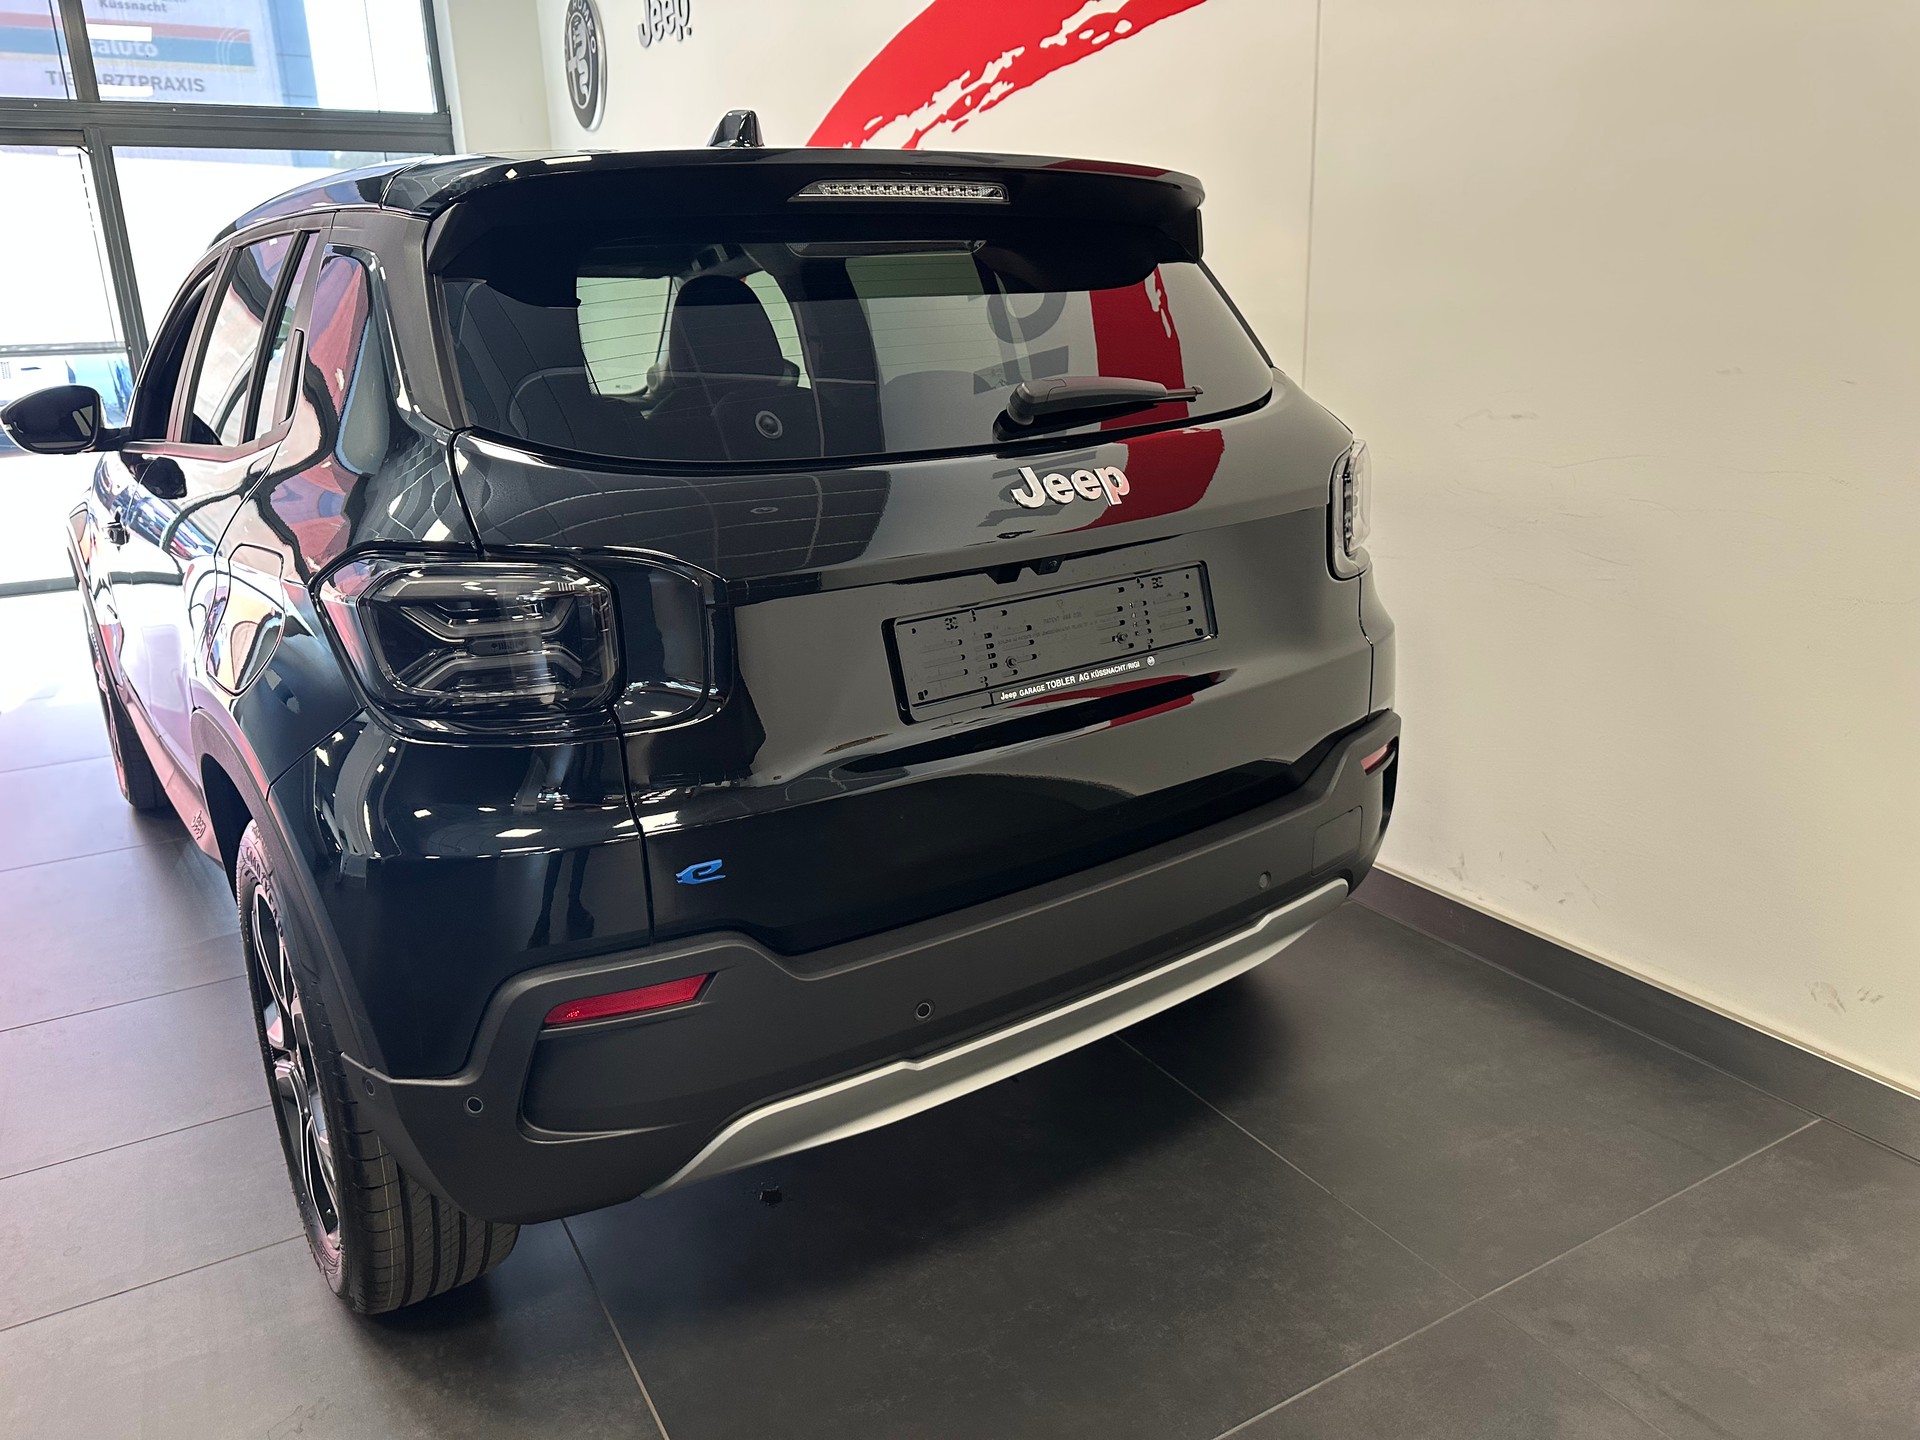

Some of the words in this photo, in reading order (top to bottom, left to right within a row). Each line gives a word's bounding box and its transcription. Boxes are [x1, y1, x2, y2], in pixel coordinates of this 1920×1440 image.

[45, 70, 206, 93] TIERZTPRAXIS
[1010, 465, 1131, 509] Jeep
[1000, 691, 1018, 701] Jeep
[1019, 684, 1046, 697] GARAGE
[1046, 675, 1076, 690] TOBLER
[1079, 672, 1090, 682] AG
